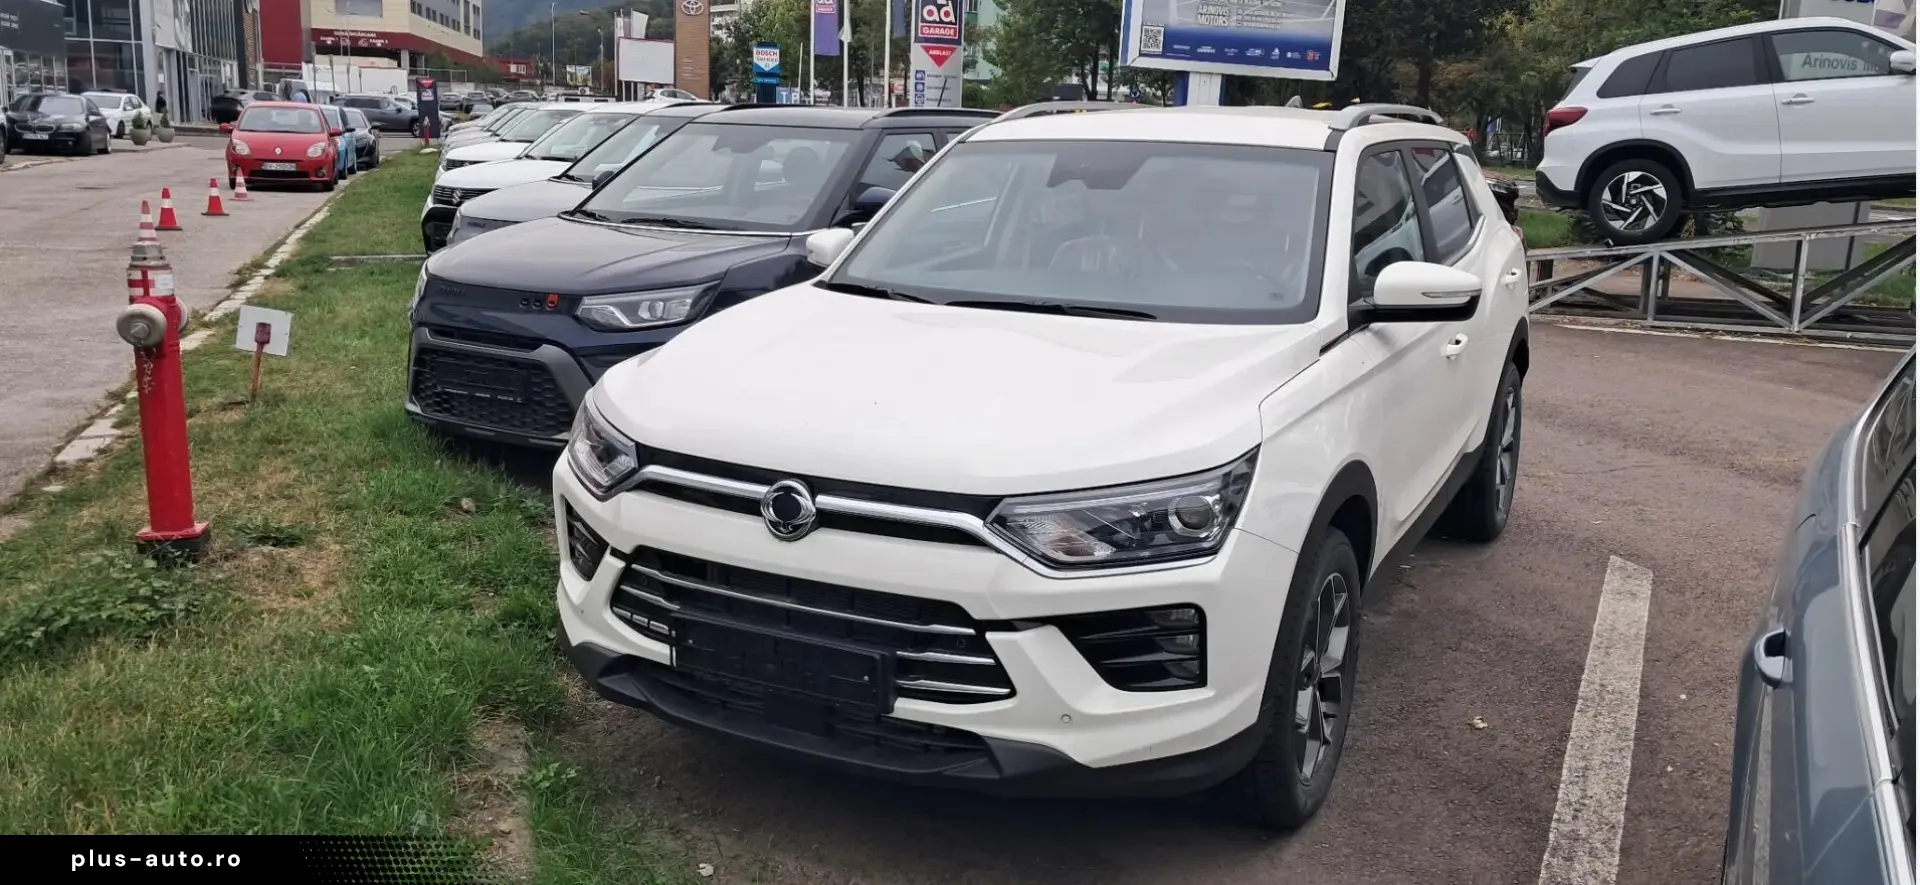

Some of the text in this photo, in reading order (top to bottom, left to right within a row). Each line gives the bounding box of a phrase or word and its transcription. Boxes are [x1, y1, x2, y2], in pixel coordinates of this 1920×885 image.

[1197, 14, 1229, 27] MOTORS
[922, 26, 955, 36] GARAGE
[1801, 53, 1858, 71] Arinovis
